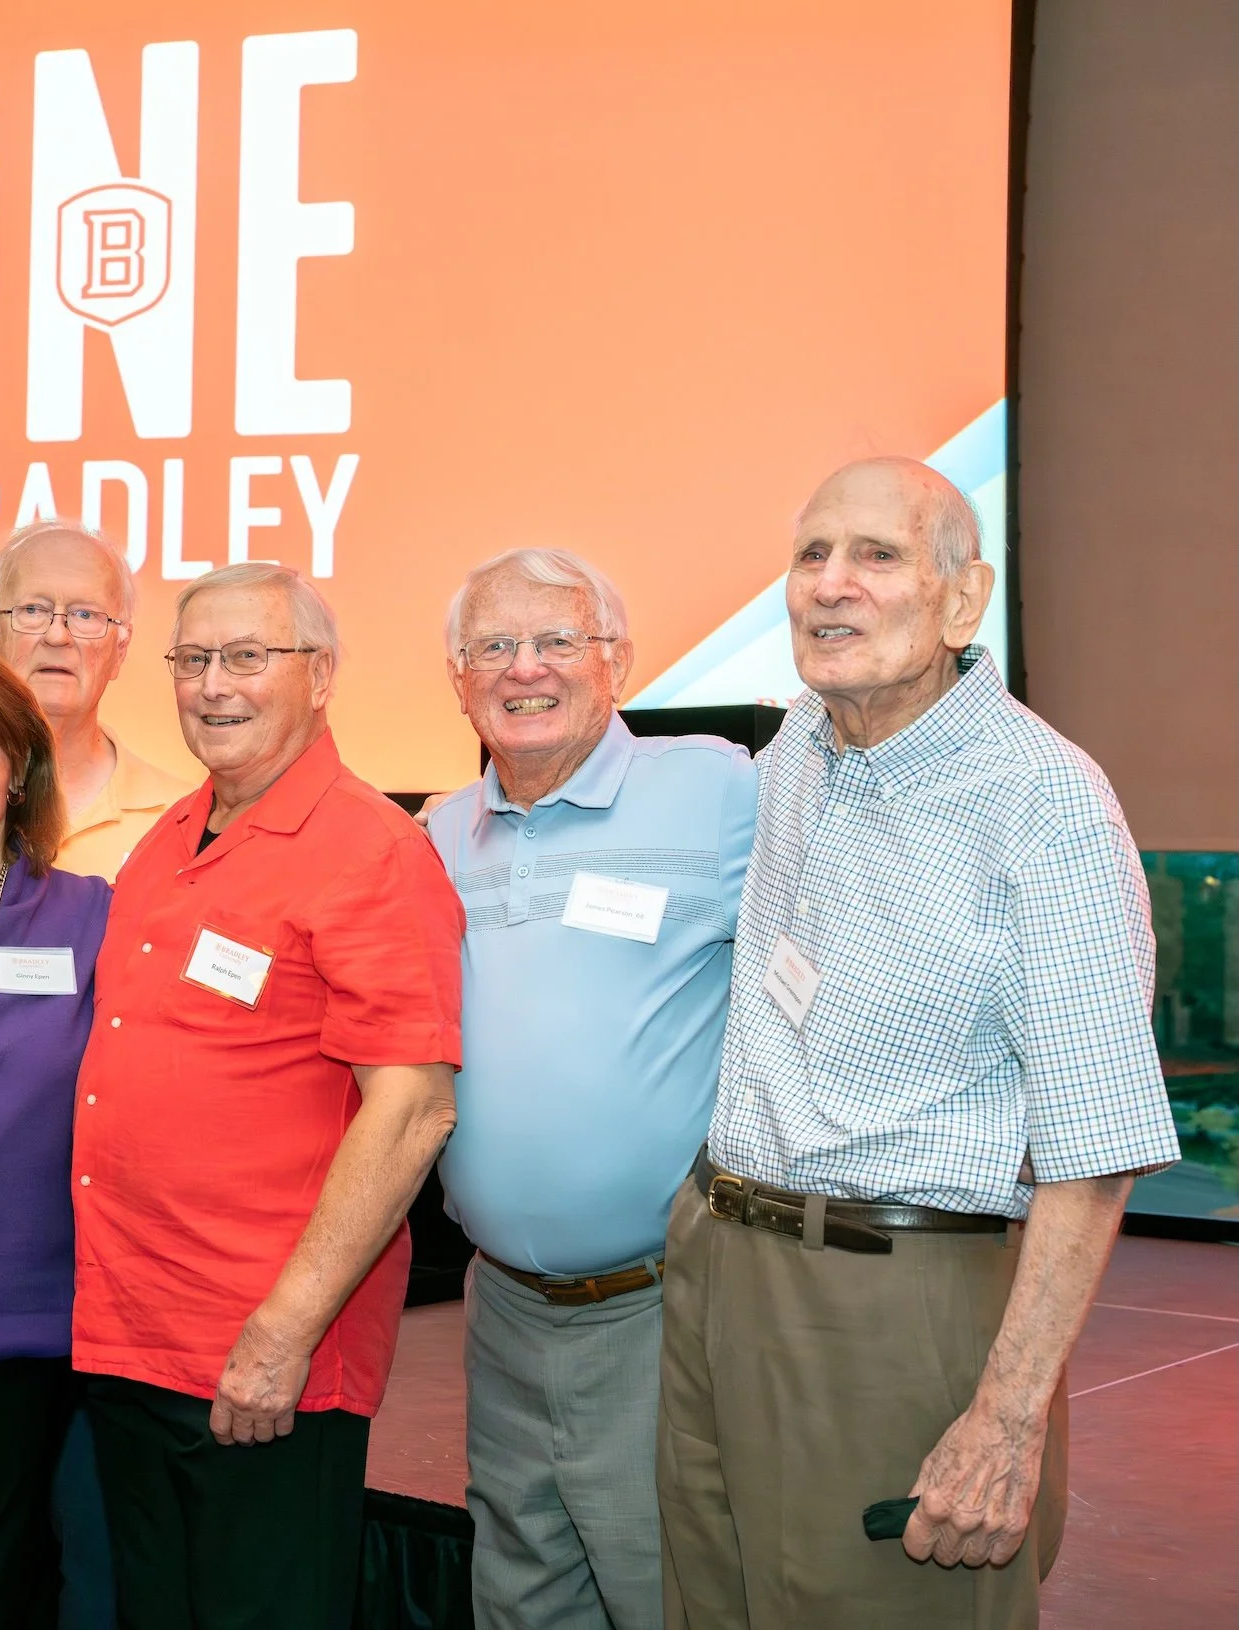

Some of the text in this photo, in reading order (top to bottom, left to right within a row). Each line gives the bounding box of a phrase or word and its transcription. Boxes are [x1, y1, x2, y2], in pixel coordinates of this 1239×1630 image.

[81, 207, 145, 299] B
[585, 901, 605, 912] James
[605, 906, 633, 918] Pearson
[221, 945, 251, 962] BRADLEY
[211, 963, 242, 981] Ralph Epen
